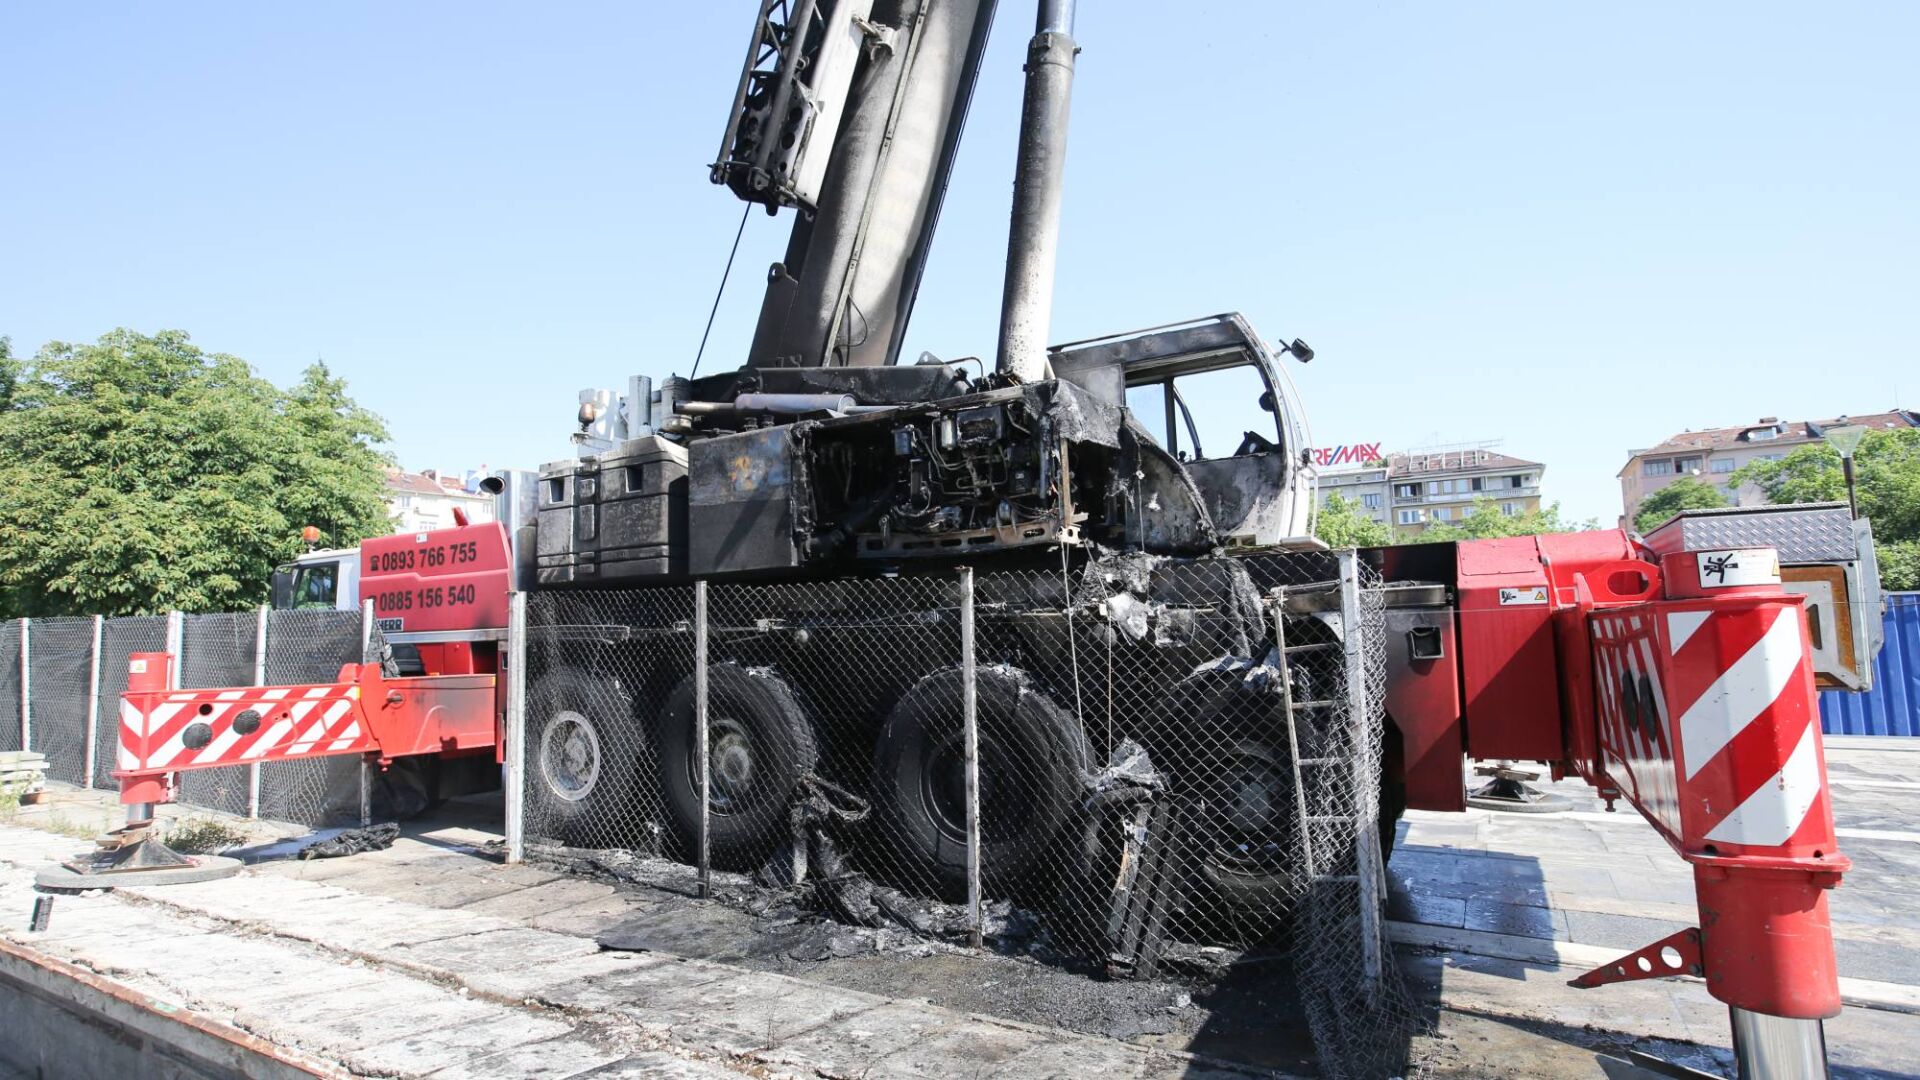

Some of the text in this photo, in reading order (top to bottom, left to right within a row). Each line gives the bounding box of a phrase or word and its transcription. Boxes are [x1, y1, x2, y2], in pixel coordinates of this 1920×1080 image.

[1313, 442, 1382, 466] RE/MAX
[382, 541, 477, 571] 0893 766 755
[380, 583, 475, 612] 0885 156 540
[377, 619, 403, 631] HERR
